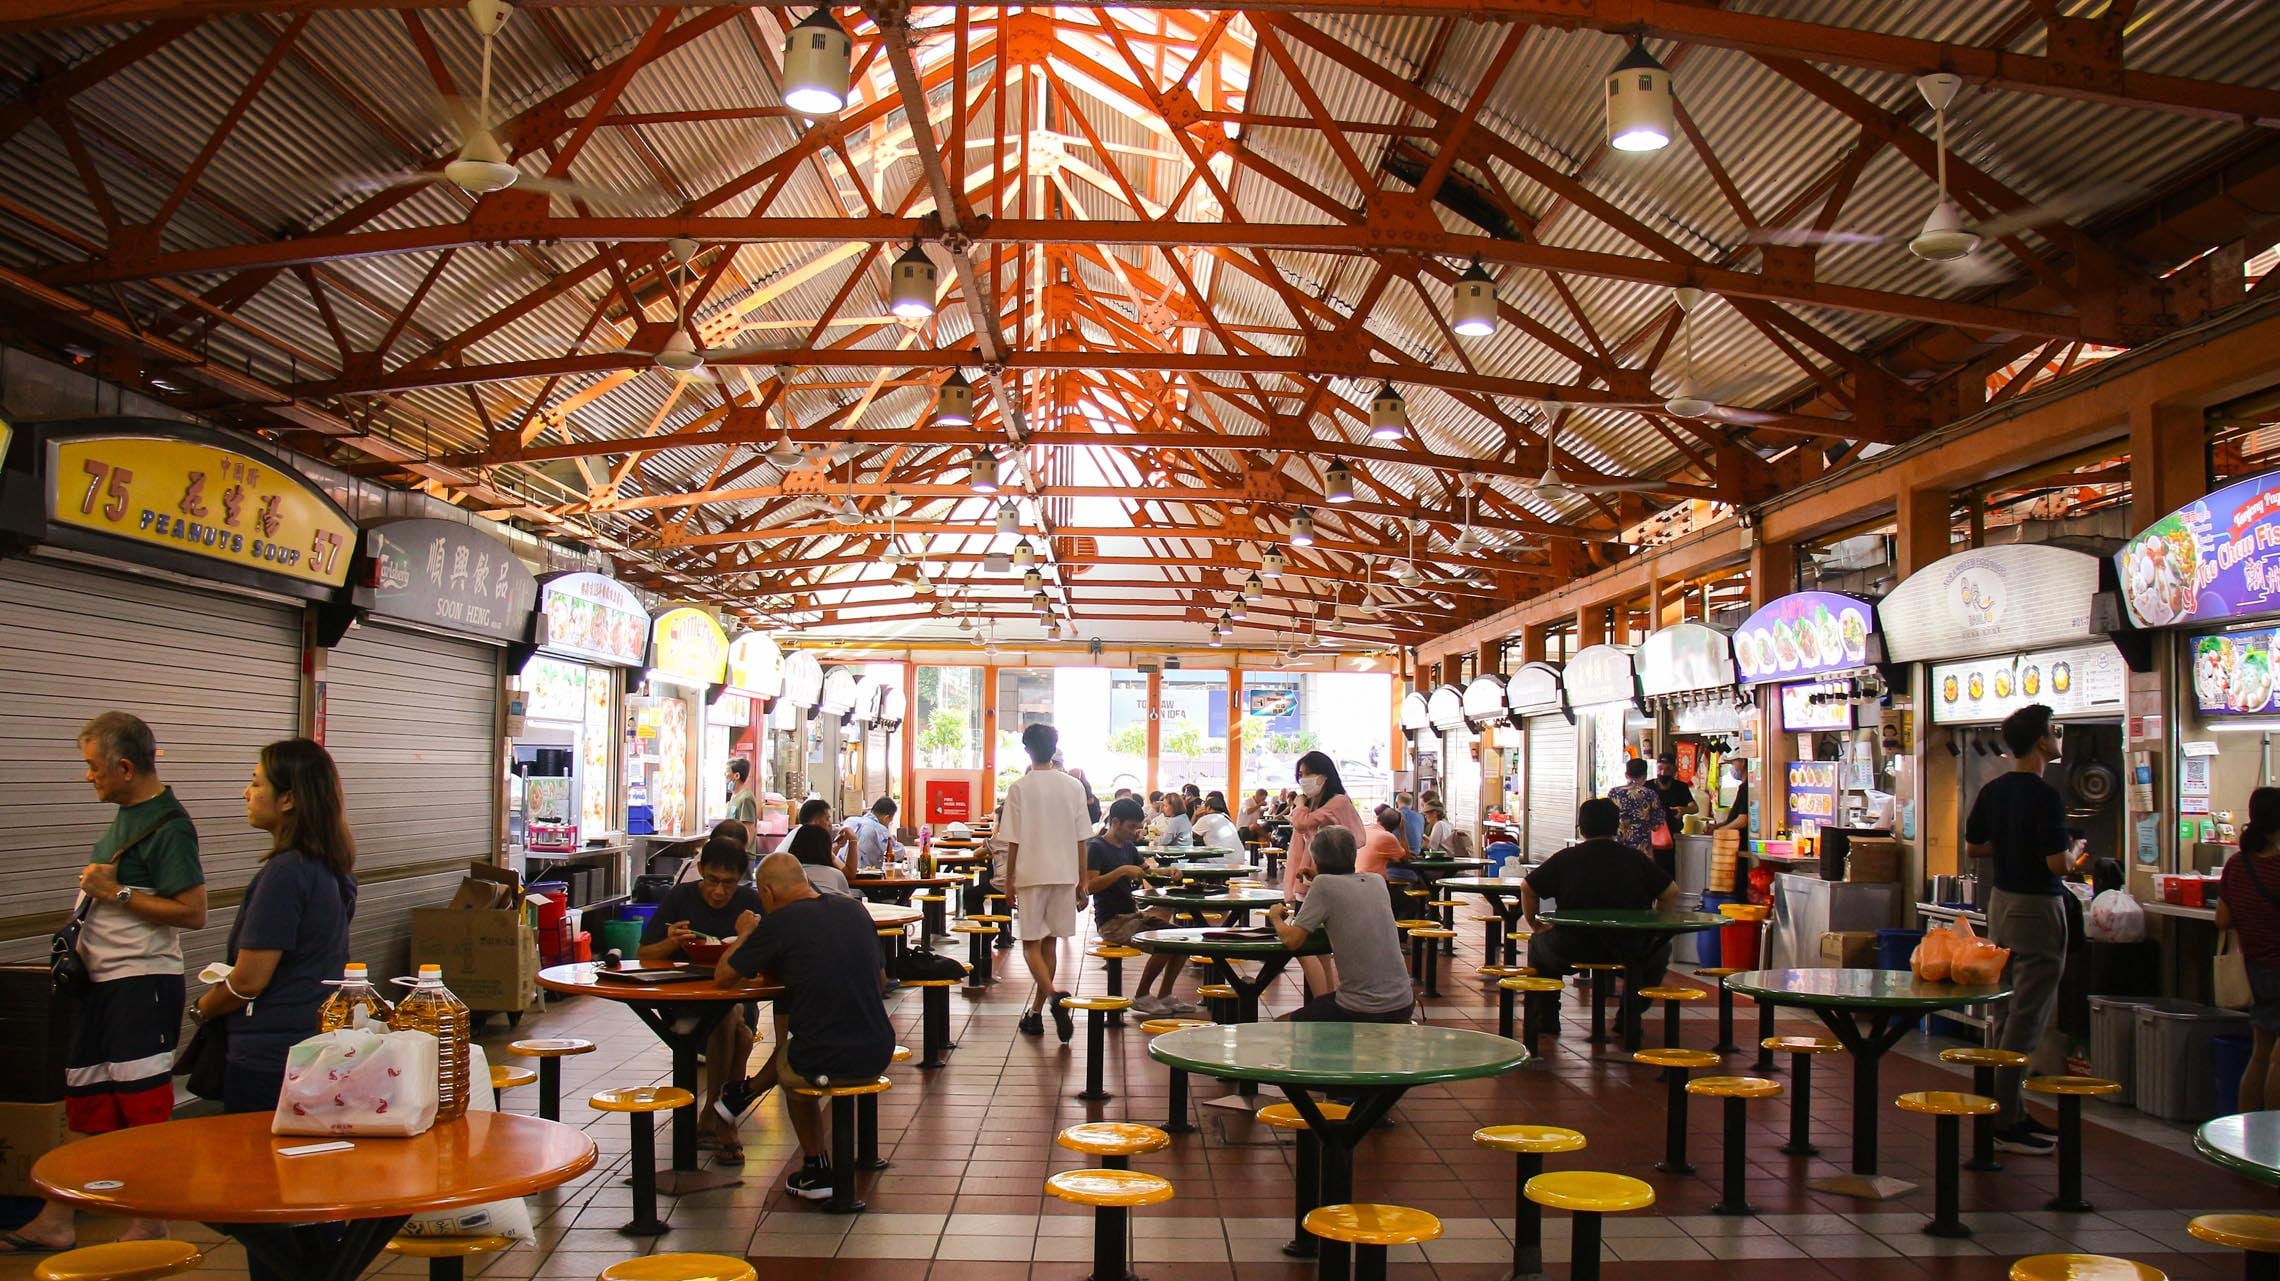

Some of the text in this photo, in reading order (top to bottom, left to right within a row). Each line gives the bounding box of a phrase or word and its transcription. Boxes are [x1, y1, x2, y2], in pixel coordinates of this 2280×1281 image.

[81, 458, 133, 522] 75
[2234, 500, 2264, 528] Tanjong
[139, 509, 301, 567] PEANUTS SOUP
[309, 528, 343, 576] 57
[436, 598, 490, 627] SOON HENG
